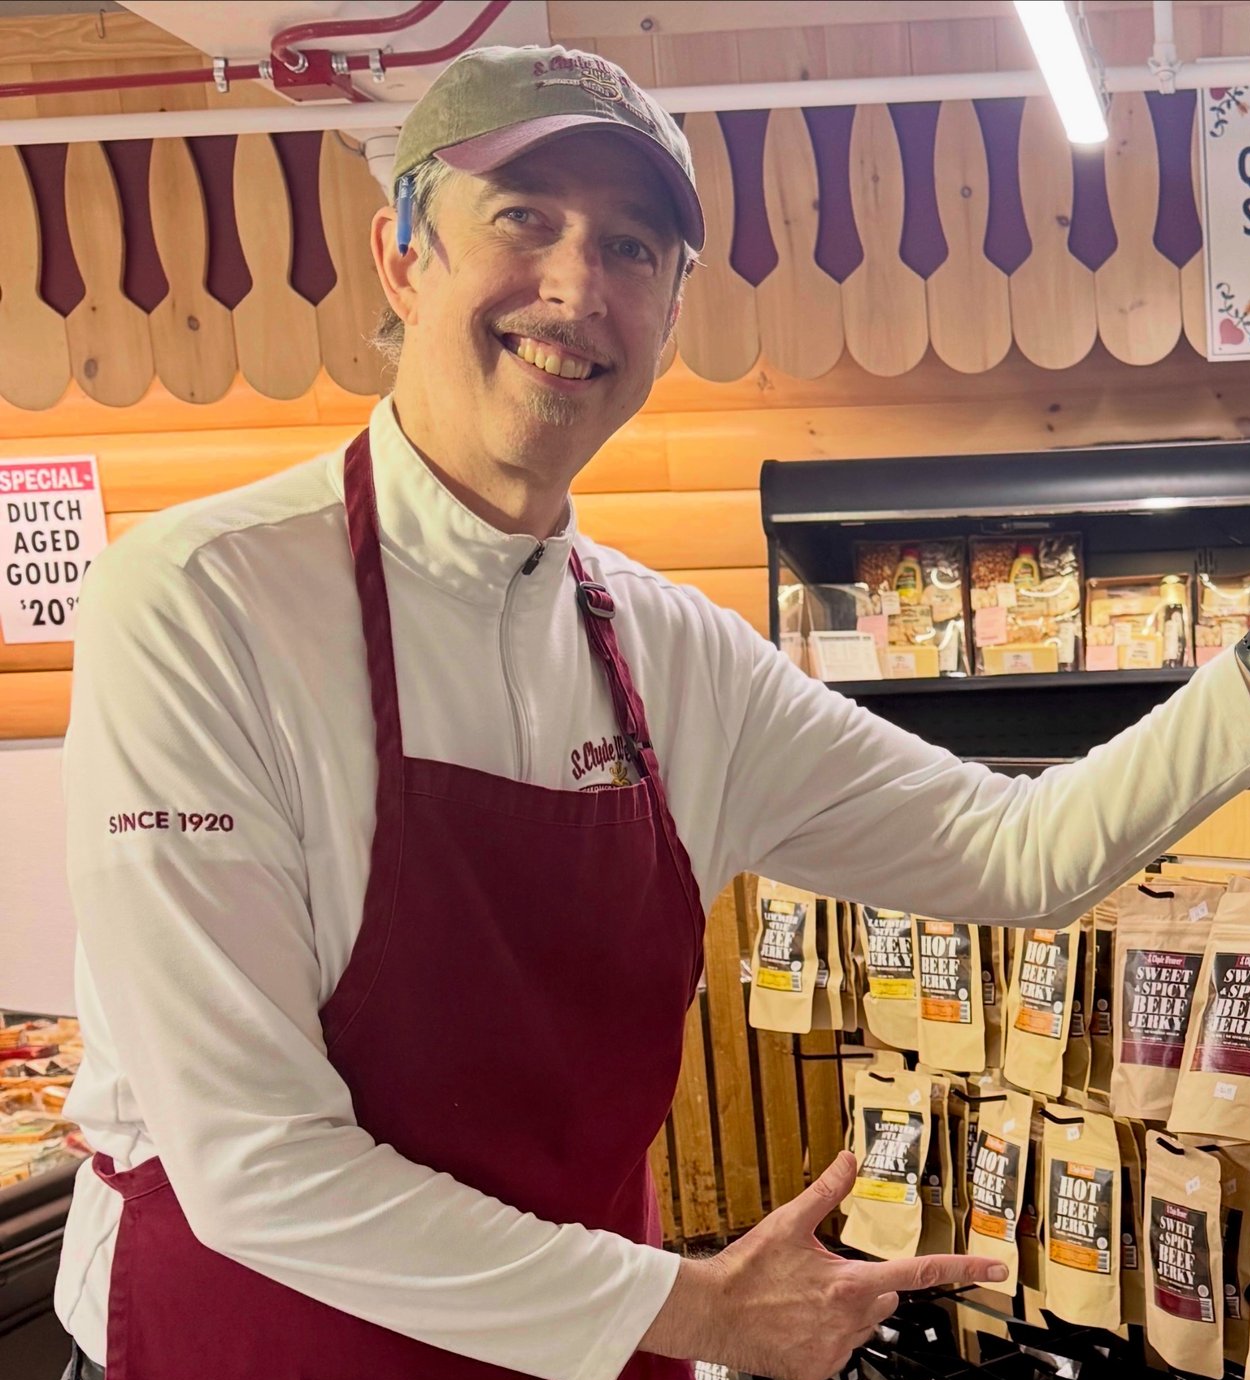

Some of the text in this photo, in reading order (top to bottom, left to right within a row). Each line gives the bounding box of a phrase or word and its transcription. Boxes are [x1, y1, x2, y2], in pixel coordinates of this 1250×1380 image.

[7, 500, 82, 523] DUTCH
[14, 529, 80, 555] AGED
[109, 810, 234, 834] SINCE 1920
[921, 935, 960, 957] HOT
[1025, 940, 1061, 967] HOT
[921, 956, 960, 976] BEEF
[1021, 961, 1057, 987] BEEF
[1136, 966, 1193, 984] SWEET
[921, 974, 959, 990] JERKY
[1141, 981, 1190, 998] SPICY
[1132, 995, 1188, 1017] BEEF
[1128, 1013, 1185, 1031] JERKY
[976, 1146, 1009, 1177] HOT
[973, 1166, 1006, 1195] BEEF
[1059, 1175, 1101, 1204] HOT
[1057, 1197, 1099, 1223] BEEF
[1054, 1215, 1098, 1238] JERKY
[1160, 1215, 1194, 1238] SWEET
[1165, 1231, 1194, 1253] SPICY
[1158, 1244, 1195, 1271] BEEF
[1157, 1261, 1196, 1285] JERKY
